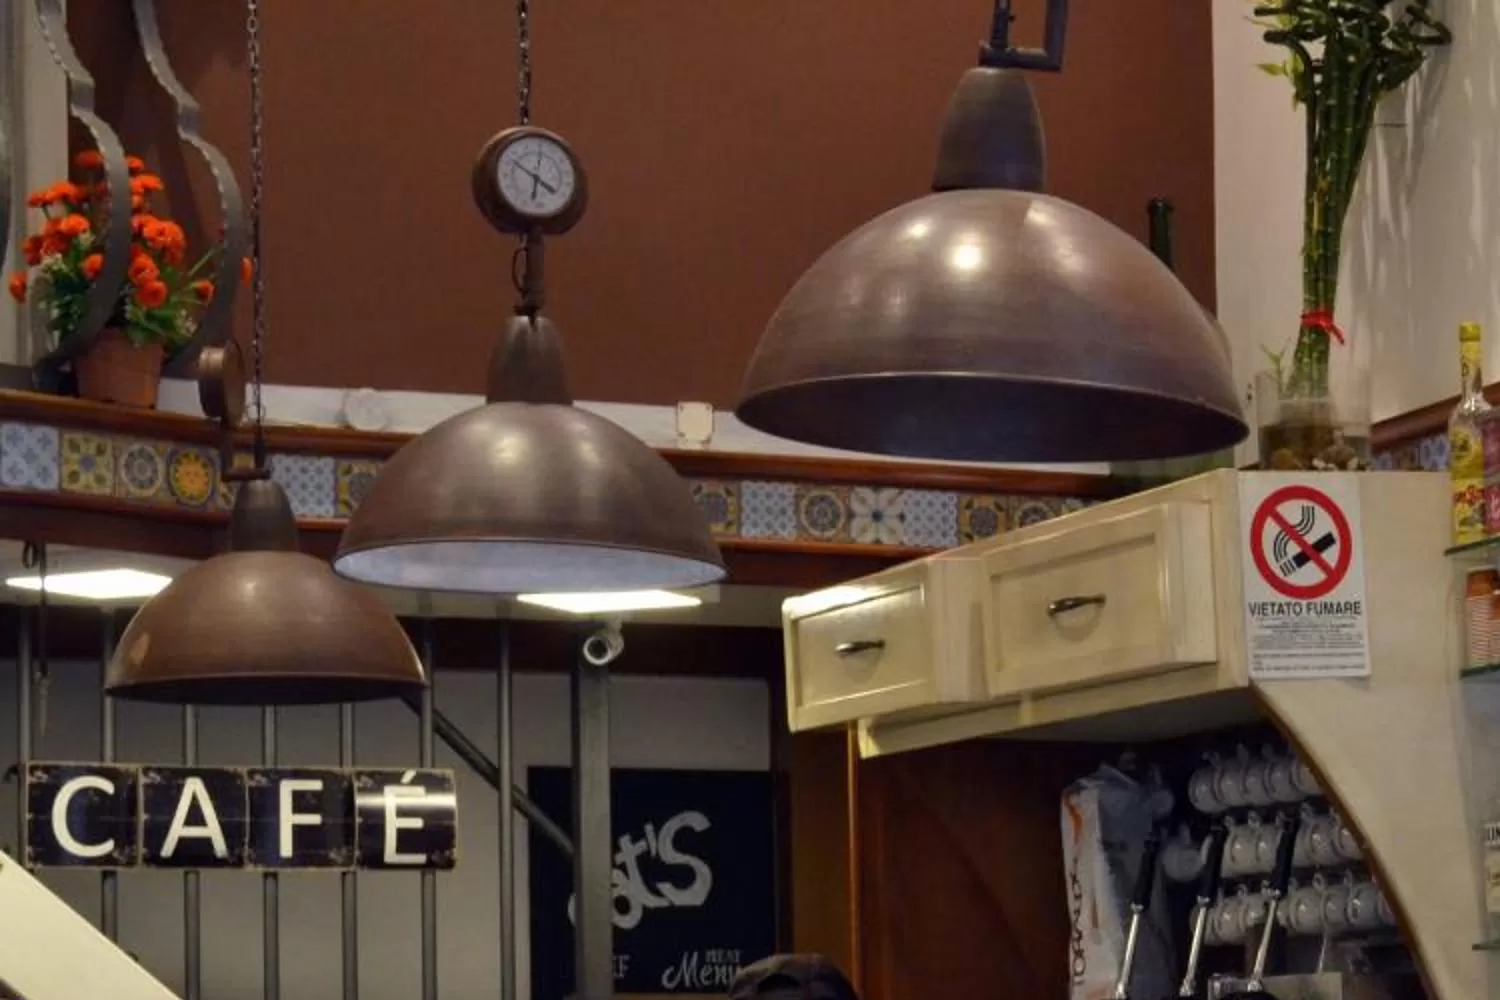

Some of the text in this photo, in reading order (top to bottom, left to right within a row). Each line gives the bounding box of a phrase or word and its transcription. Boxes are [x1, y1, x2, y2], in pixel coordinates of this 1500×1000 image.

[1248, 600, 1362, 617] VIETATO FUMARE
[50, 769, 429, 865] CAFÉ
